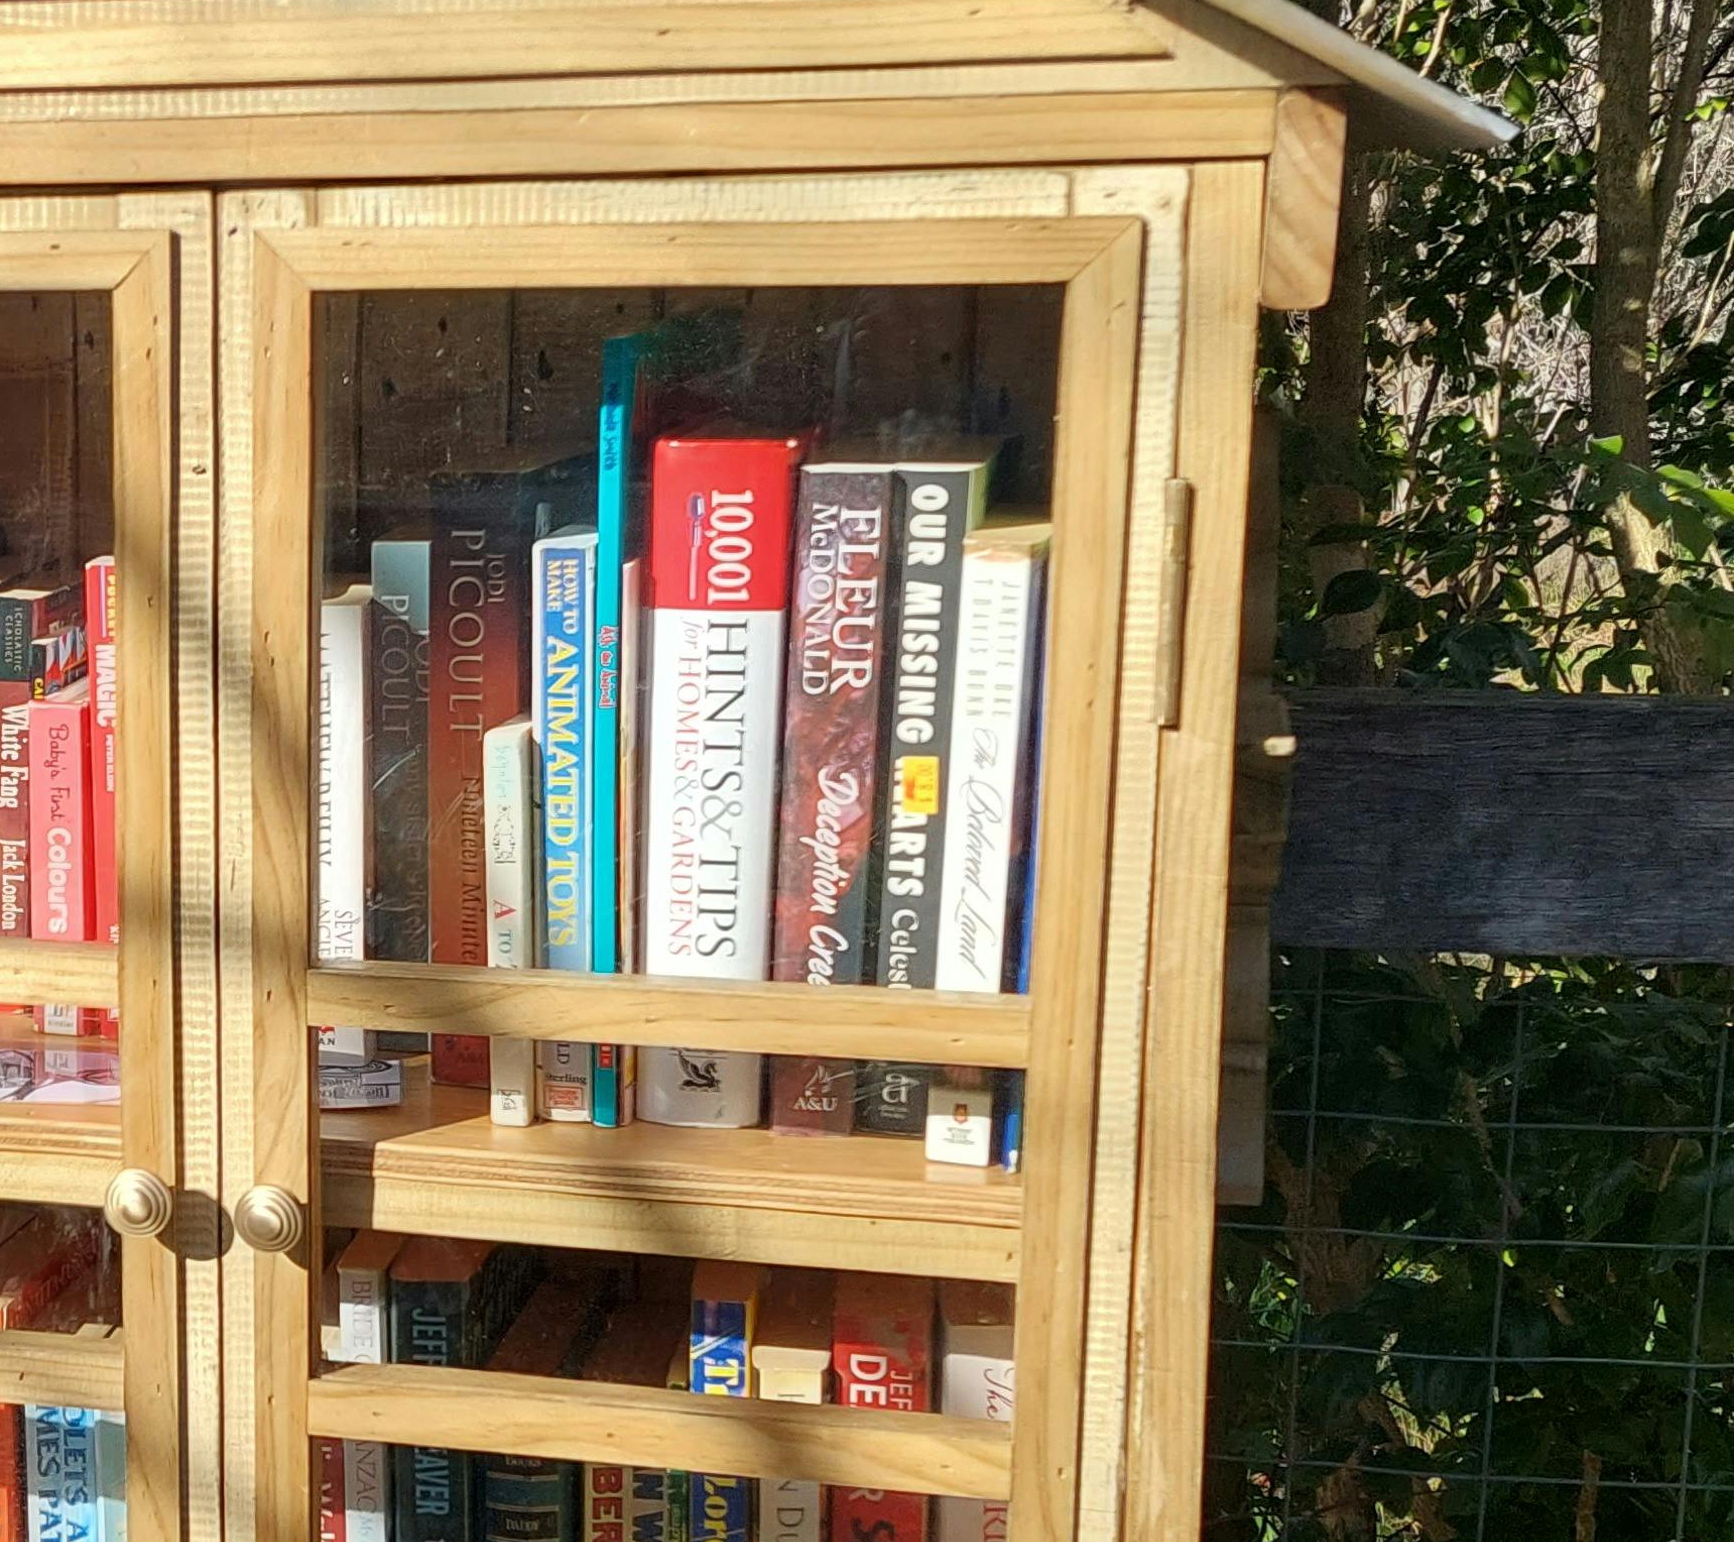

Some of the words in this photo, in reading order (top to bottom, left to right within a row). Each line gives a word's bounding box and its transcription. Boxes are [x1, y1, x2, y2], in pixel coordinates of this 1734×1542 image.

[704, 489, 754, 606] 10,001
[906, 482, 950, 566] OUR
[486, 552, 506, 604] JODI
[546, 559, 564, 612] MAKE
[562, 558, 580, 606] HOW
[801, 501, 839, 696] McDONALD
[829, 504, 882, 695] FLEUR
[448, 528, 488, 741] PICOULT
[562, 607, 579, 635] TO
[681, 619, 704, 649] for
[896, 579, 945, 743] MISSING
[380, 593, 413, 737] PICOULT
[0, 703, 30, 761] White
[44, 723, 71, 780] Baby's
[545, 634, 580, 847] ANIMATED
[972, 727, 998, 770] The
[48, 785, 70, 822] First
[459, 776, 483, 874] Nineteen
[798, 765, 860, 916] Deception
[886, 757, 930, 897] ARTS
[959, 774, 1006, 895] Beloved
[1, 874, 26, 931] London
[46, 826, 73, 934] Colours
[544, 850, 580, 947] TOYS
[460, 879, 486, 967] Minute
[496, 929, 514, 955] TO
[807, 924, 850, 985] Cree
[887, 908, 920, 989] Celest
[956, 895, 997, 980] Land
[793, 1096, 838, 1112] A&U
[351, 1279, 376, 1349] BRIDE
[34, 1406, 62, 1480] MES
[59, 1408, 90, 1507] OLETS
